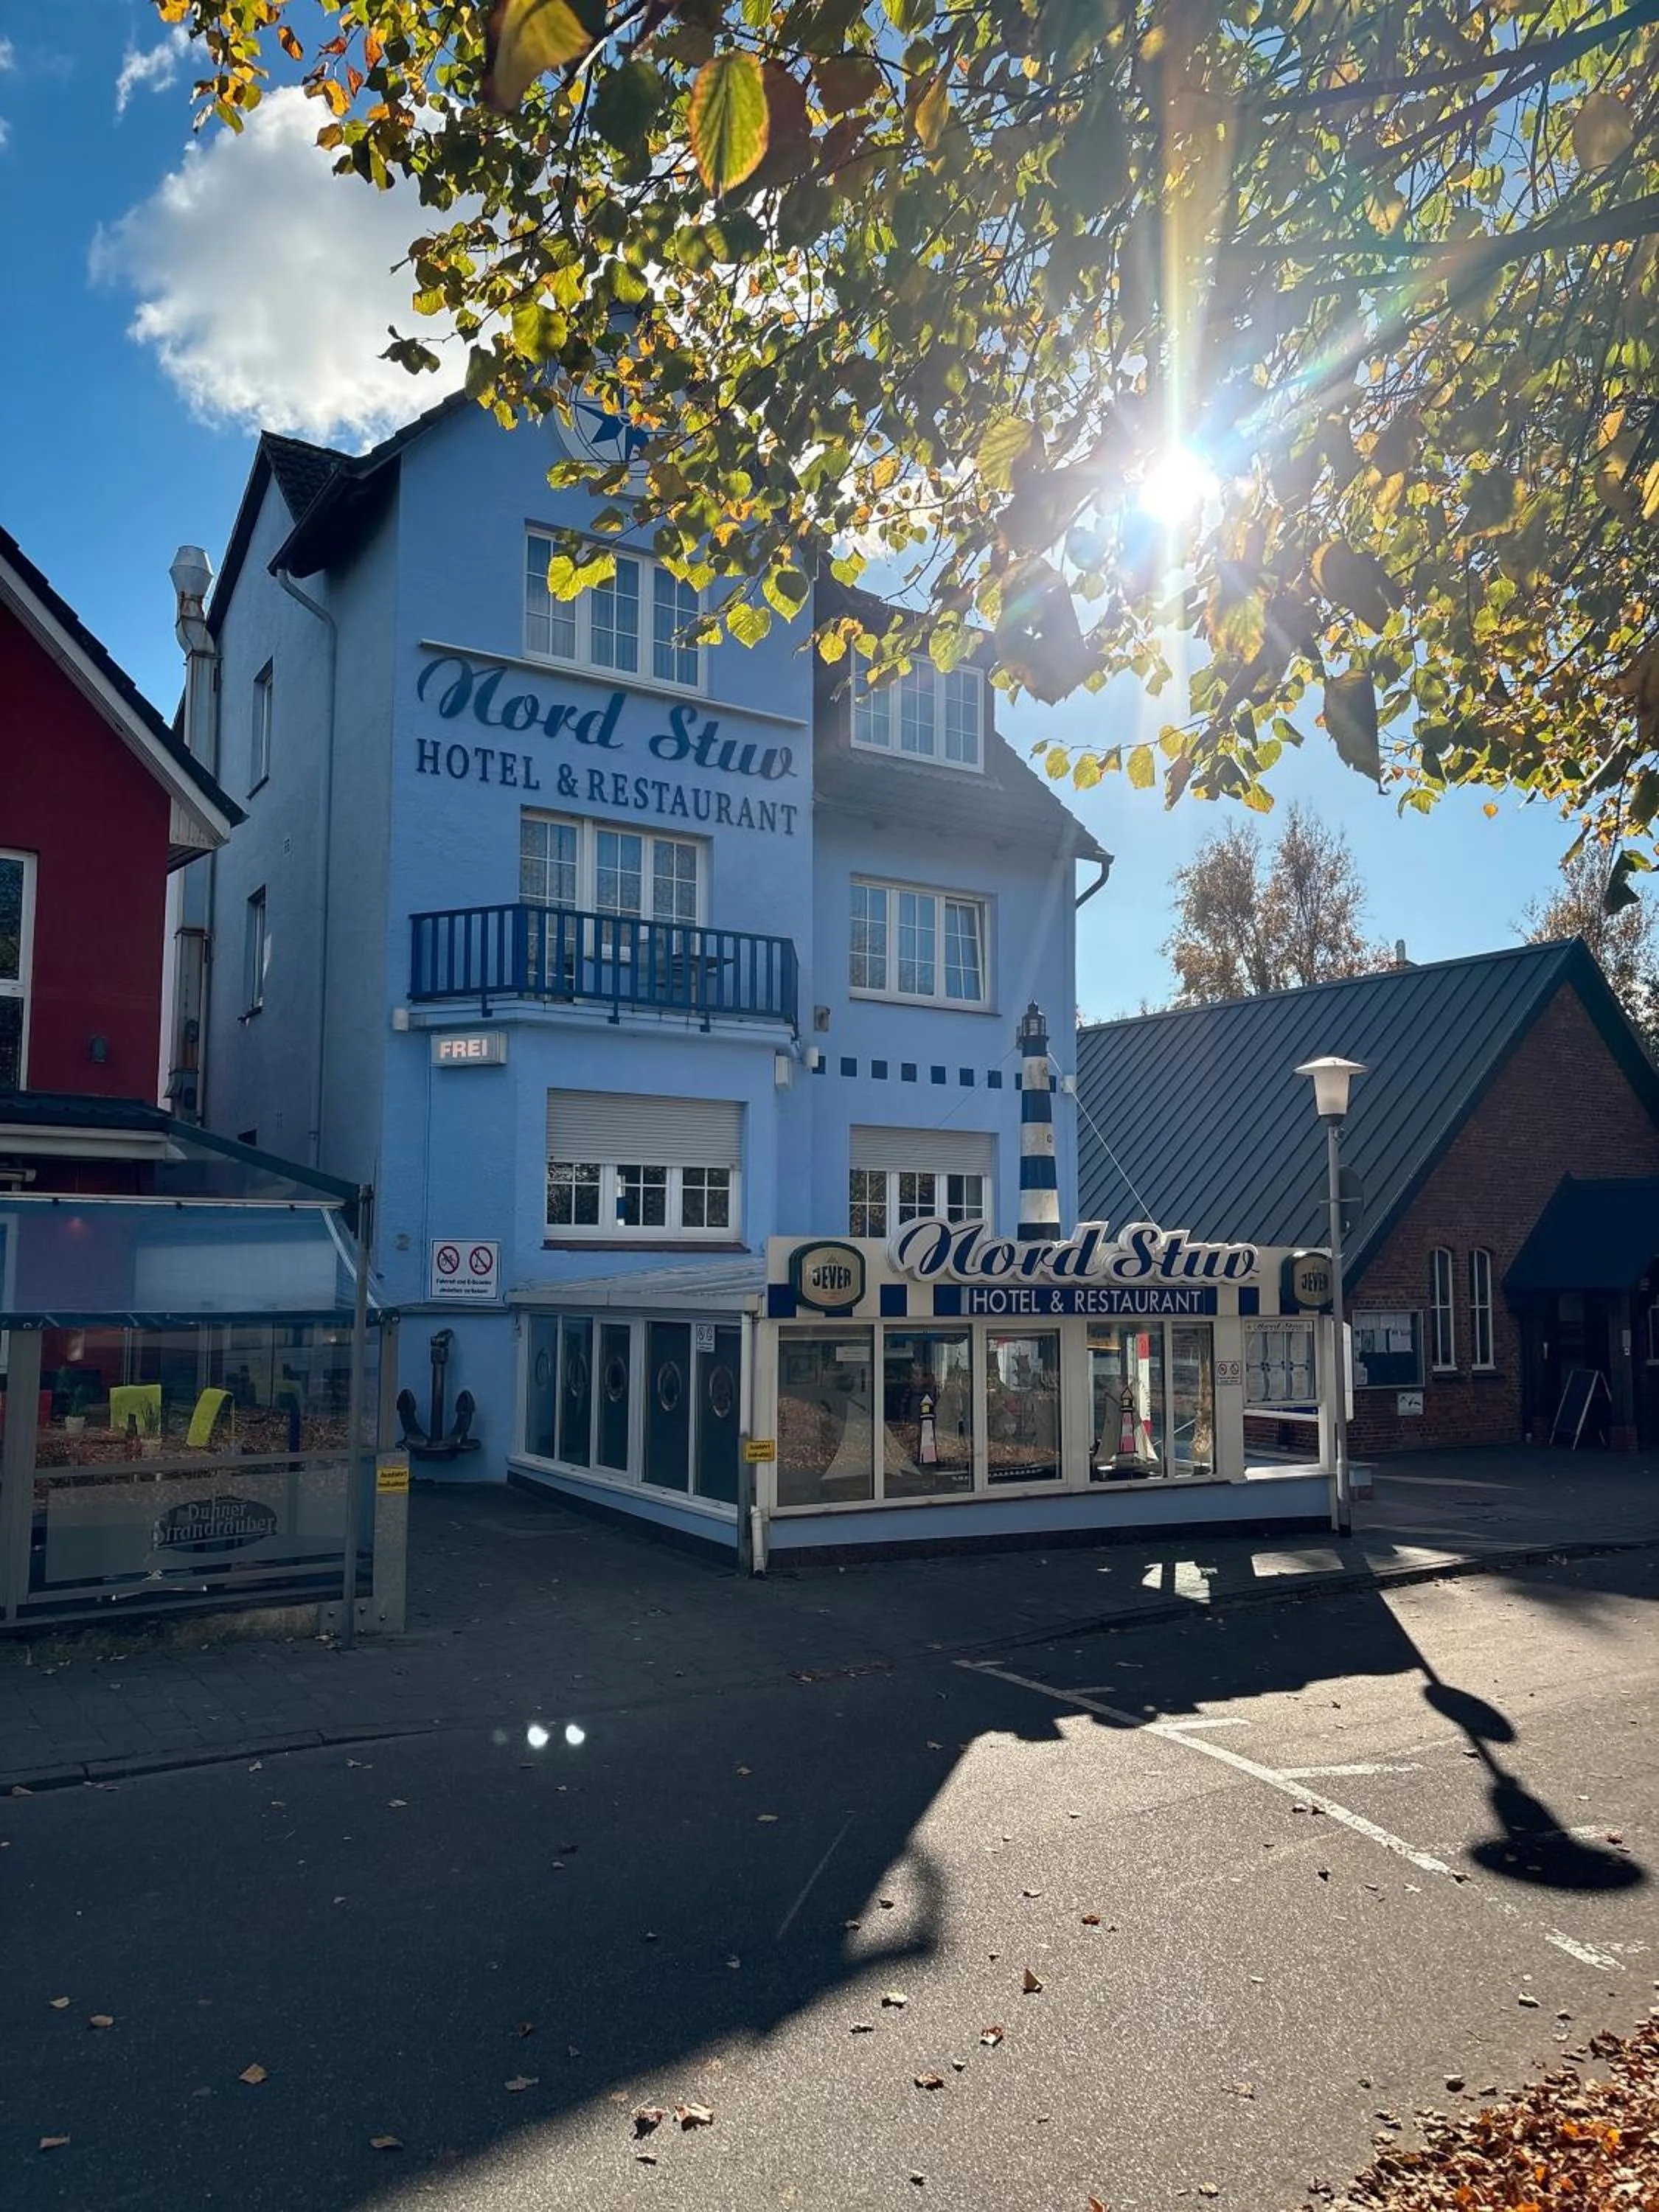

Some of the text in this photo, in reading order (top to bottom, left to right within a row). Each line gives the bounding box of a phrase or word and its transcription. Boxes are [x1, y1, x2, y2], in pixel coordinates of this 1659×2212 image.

[417, 656, 798, 781] Nord Stuv
[416, 737, 798, 835] HOTEL & RESTAURANT
[439, 1038, 487, 1060] FREI
[898, 1221, 1260, 1279] Nord Stuv
[812, 1265, 852, 1290] JEVER
[1301, 1272, 1329, 1292] JEVER
[973, 1289, 1202, 1314] HOTEL & RESTAURANT
[188, 1503, 247, 1521] Duhner
[153, 1514, 276, 1545] Strandräuber
